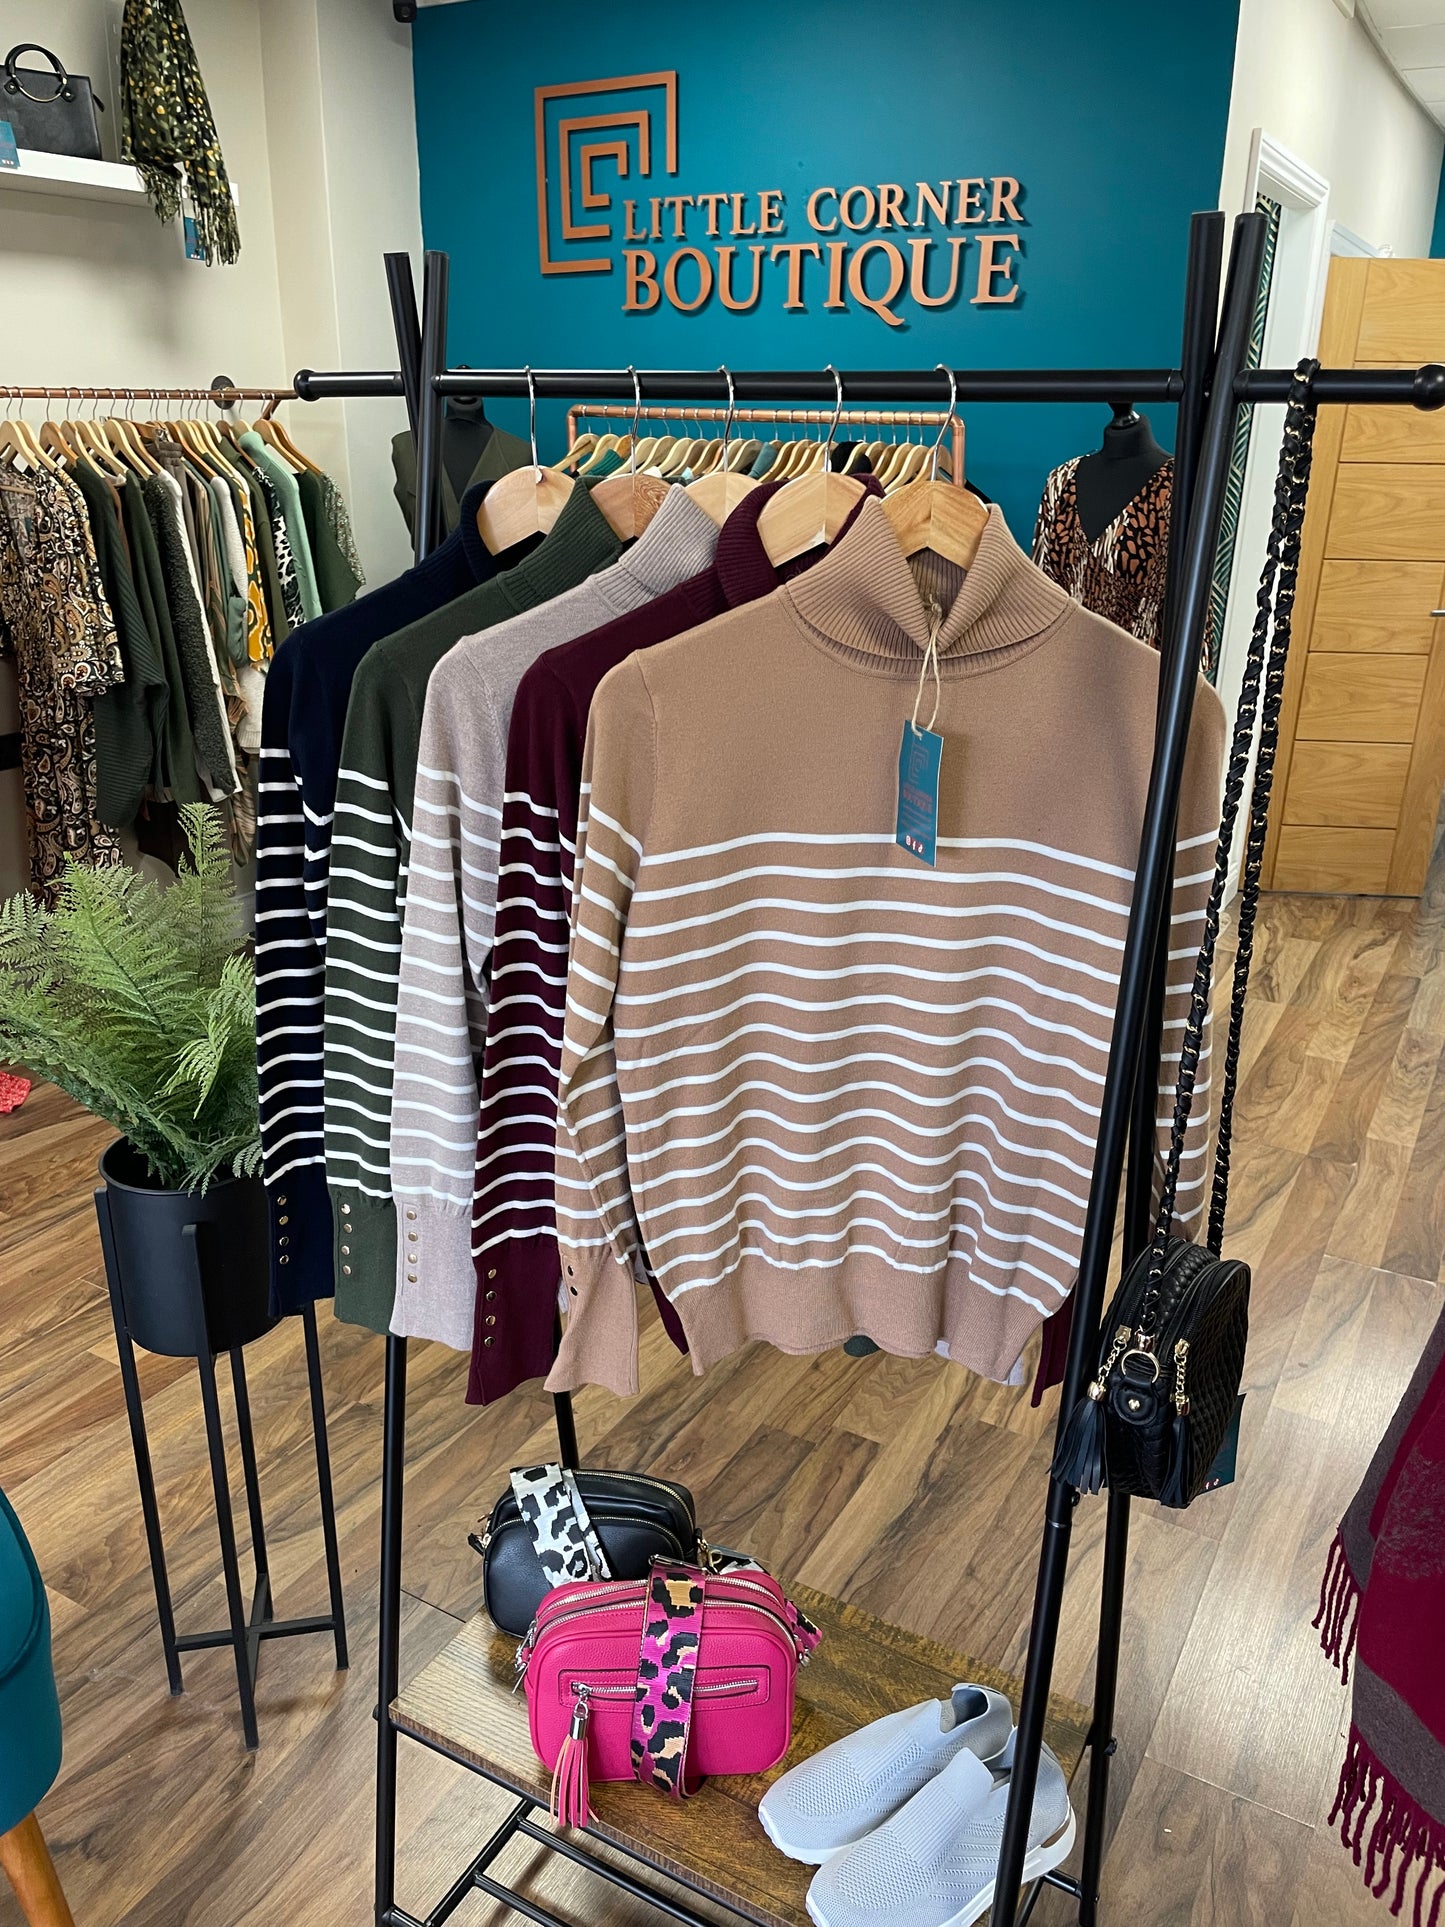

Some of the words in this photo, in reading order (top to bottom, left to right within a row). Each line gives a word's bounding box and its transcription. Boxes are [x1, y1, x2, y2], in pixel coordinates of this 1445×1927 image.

[623, 189, 785, 240] LITTLE
[806, 176, 1024, 232] CORNER
[621, 233, 1020, 327] BOUTIQUE
